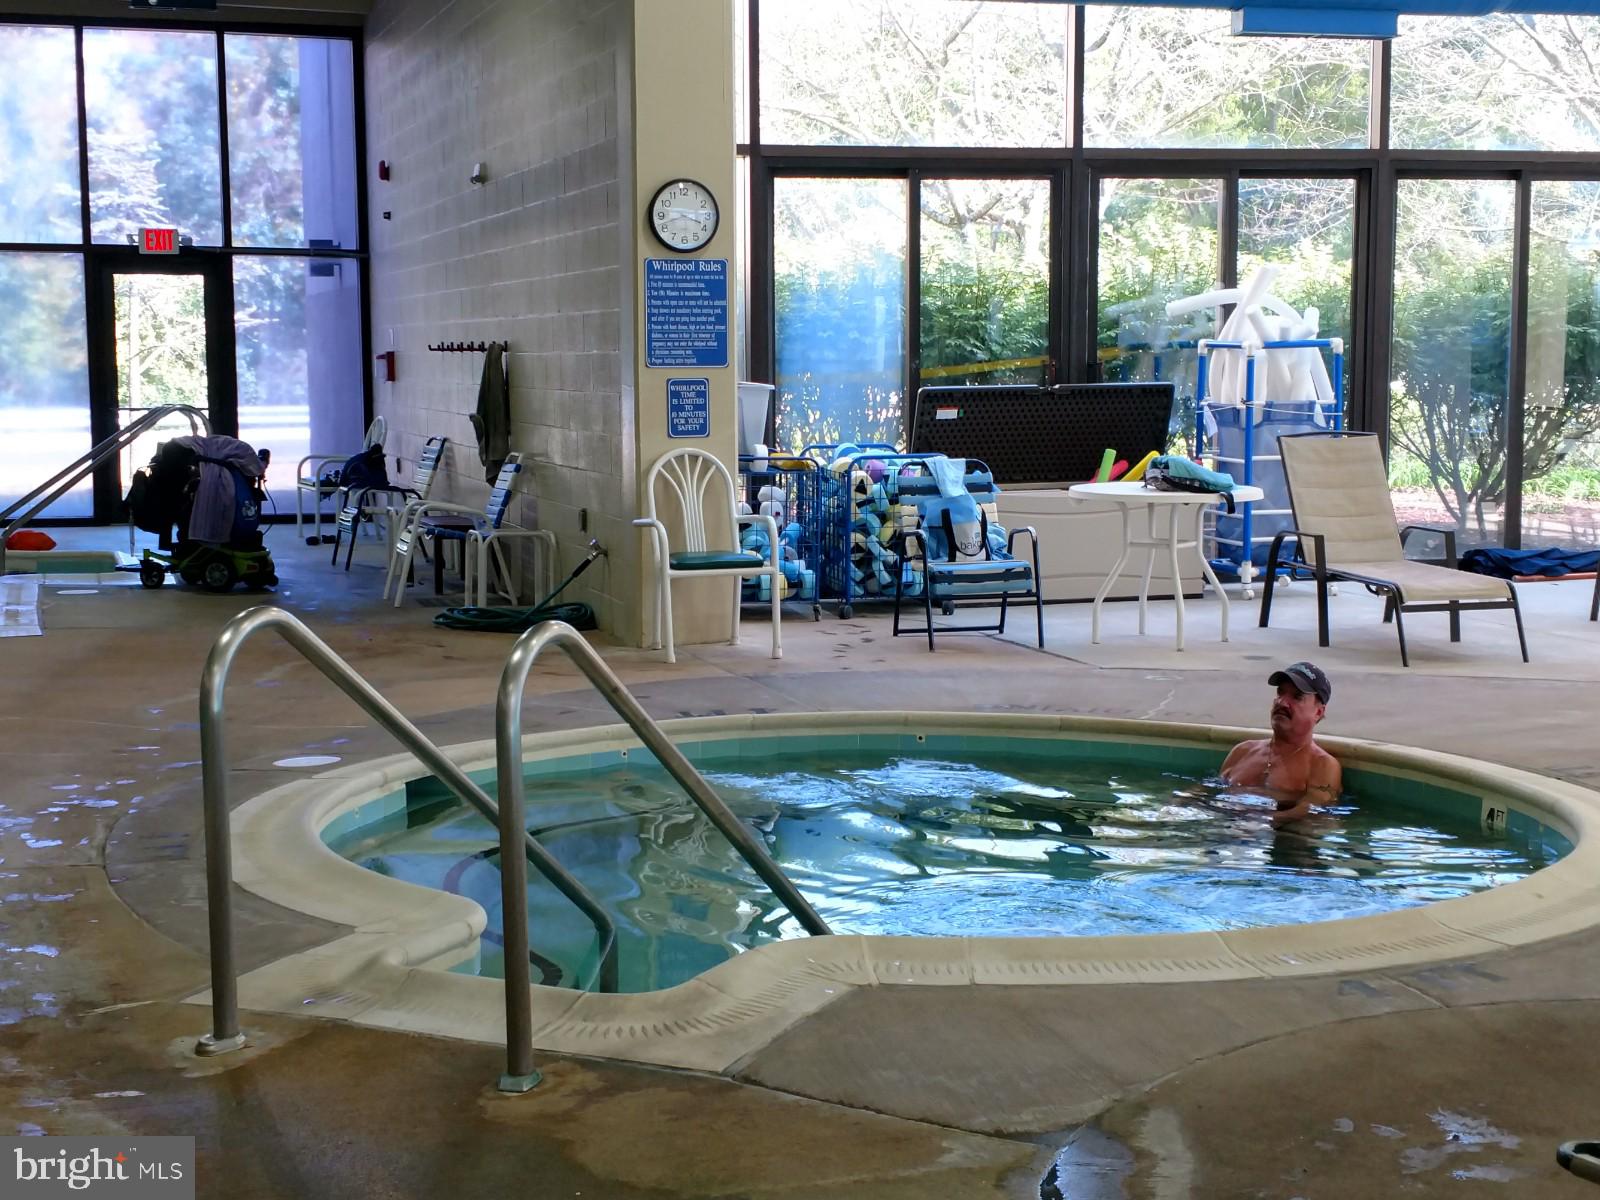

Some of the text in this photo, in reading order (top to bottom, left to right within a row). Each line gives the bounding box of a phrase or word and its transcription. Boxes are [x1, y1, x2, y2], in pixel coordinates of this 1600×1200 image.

[680, 188, 688, 196] 12
[701, 200, 707, 208] 2
[658, 212, 664, 220] 9
[705, 212, 711, 220] 3
[662, 224, 668, 232] 8
[144, 230, 173, 251] EXIT
[693, 233, 699, 241] 5
[652, 261, 721, 272] Whirlpool Rules
